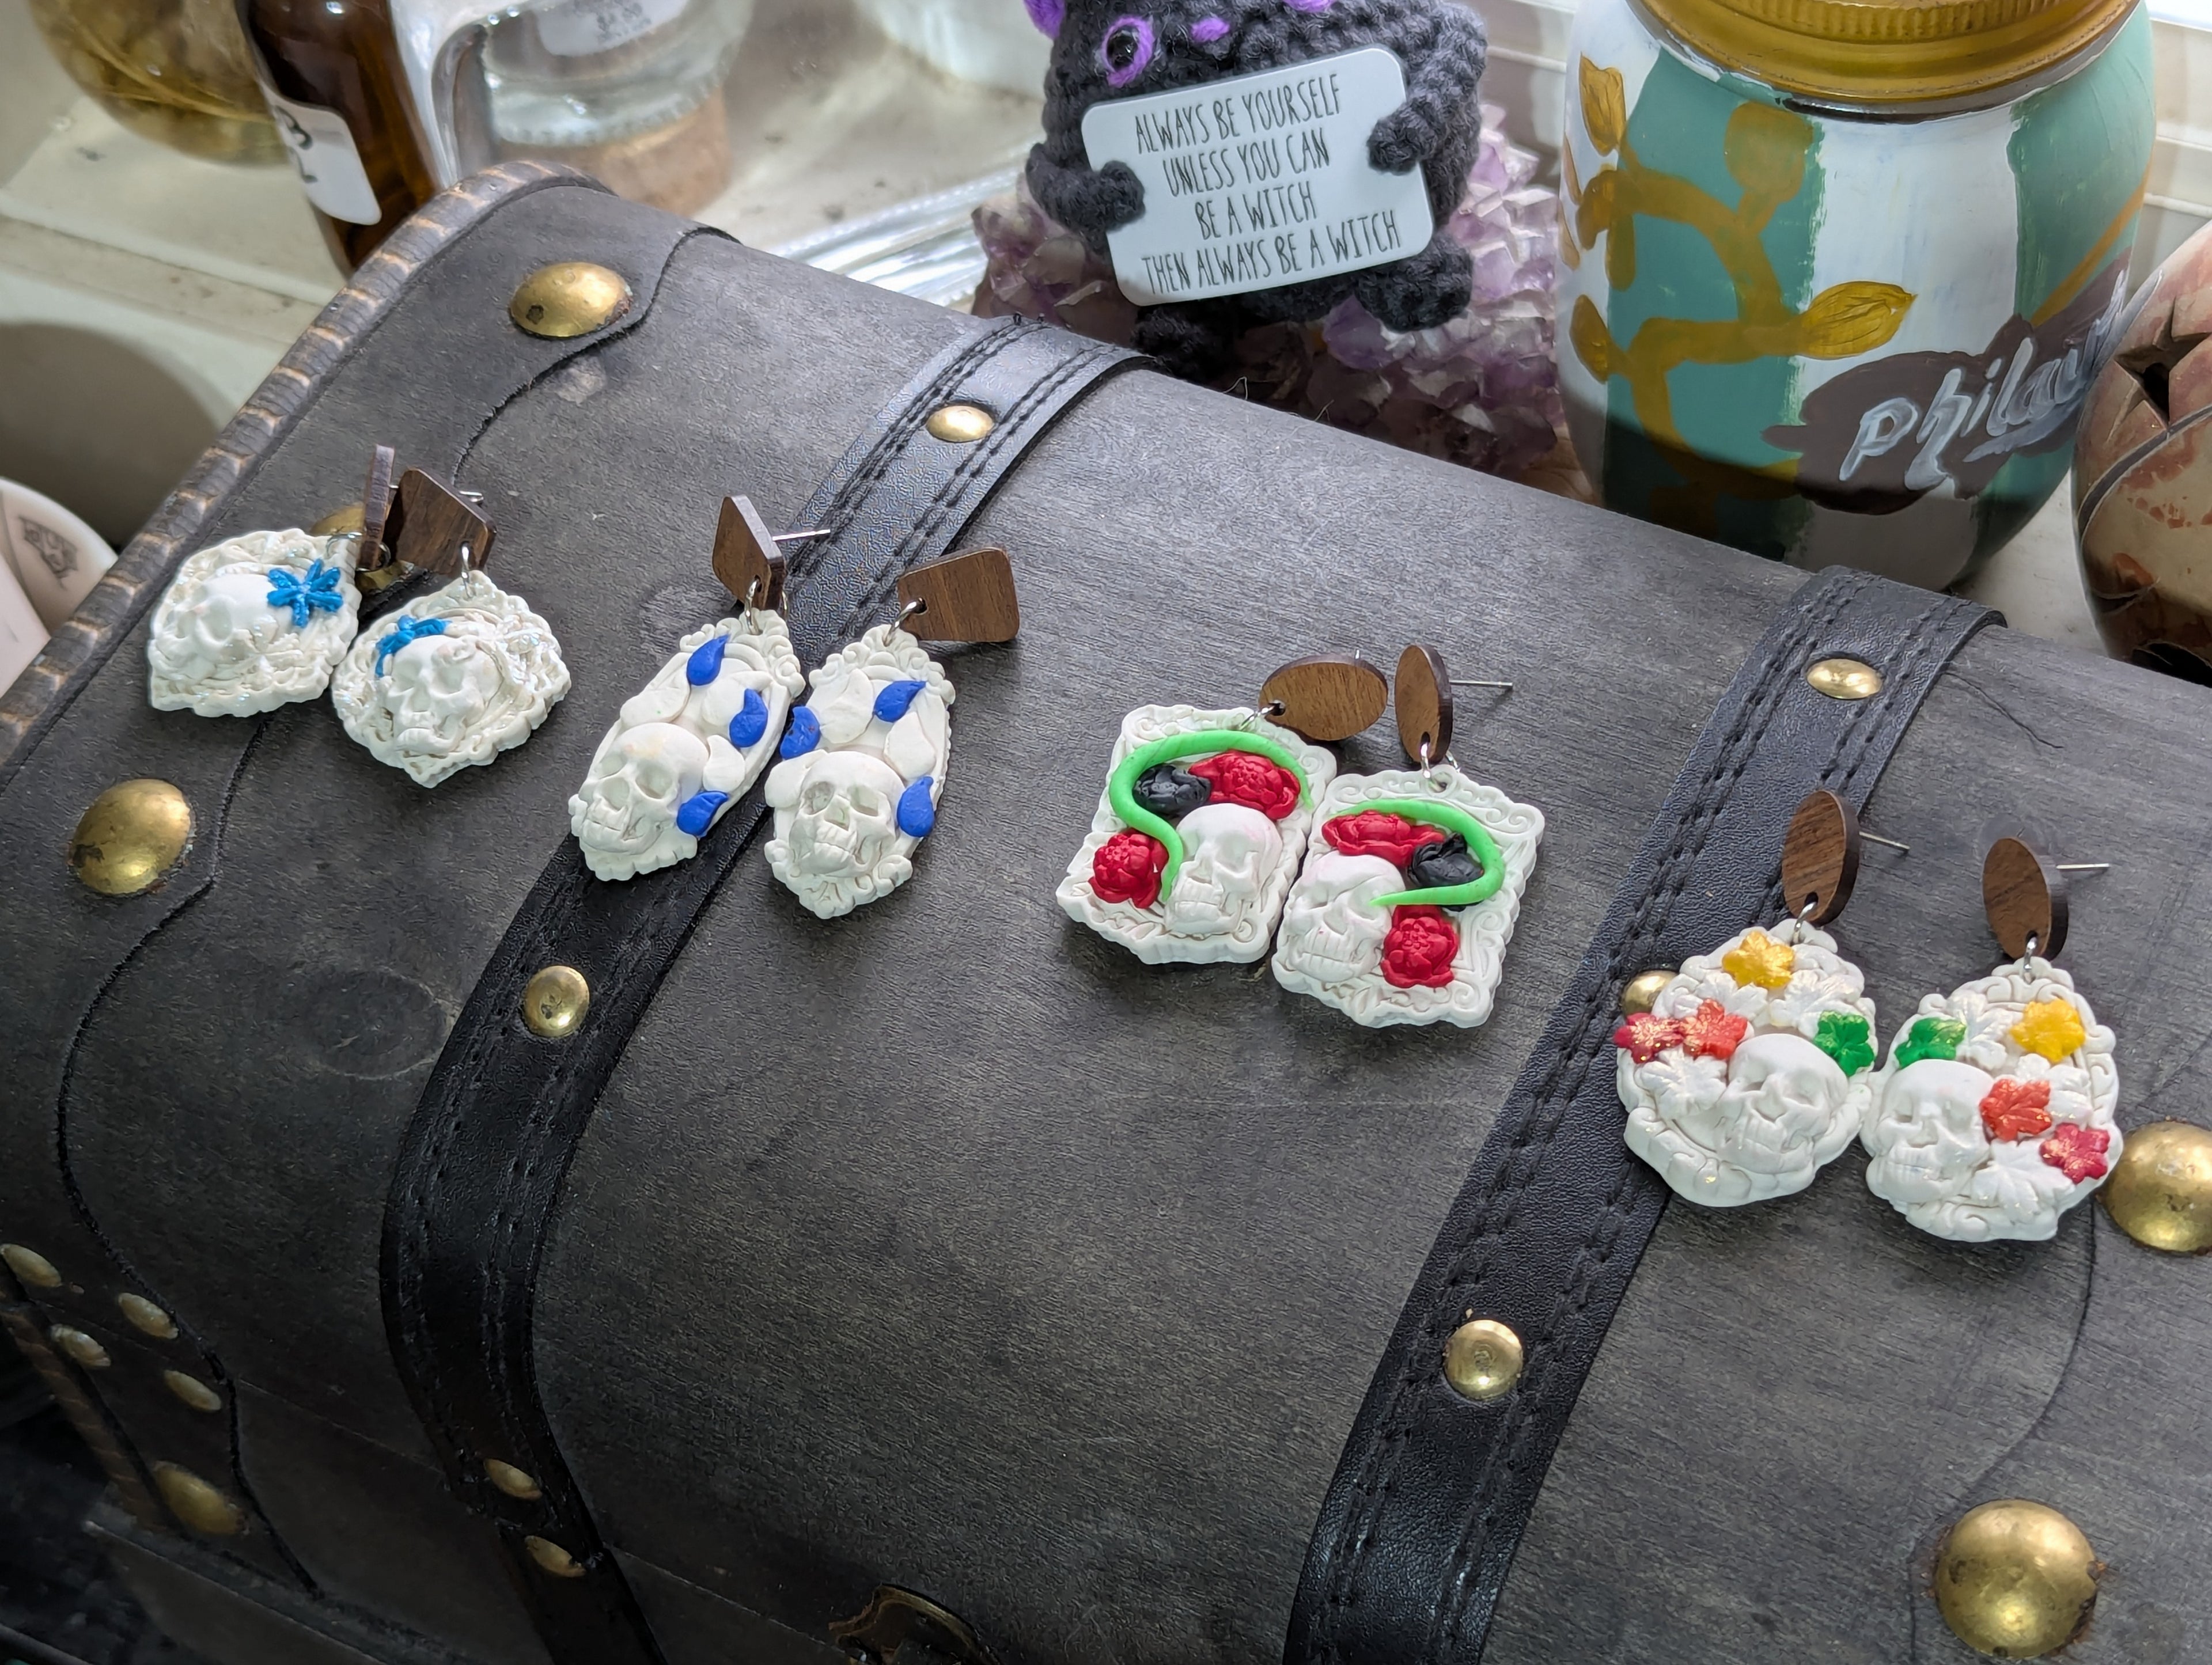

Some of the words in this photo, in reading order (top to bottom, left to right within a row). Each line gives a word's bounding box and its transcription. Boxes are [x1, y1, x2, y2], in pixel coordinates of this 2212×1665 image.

[1135, 104, 1210, 154] ALWAYS
[1213, 98, 1240, 140] BE
[1241, 74, 1340, 133] YOURSELF
[1163, 149, 1235, 198] UNLESS
[1237, 138, 1281, 184] YOU
[1285, 127, 1330, 174] CAN
[1195, 200, 1222, 240] BE
[1227, 196, 1243, 236] A
[1243, 181, 1317, 232] WITCH
[1142, 252, 1191, 294] THEN
[1196, 239, 1271, 288] ALWAYS
[1275, 233, 1302, 274] BE
[1310, 229, 1326, 268] A
[1325, 210, 1401, 263] WITCH
